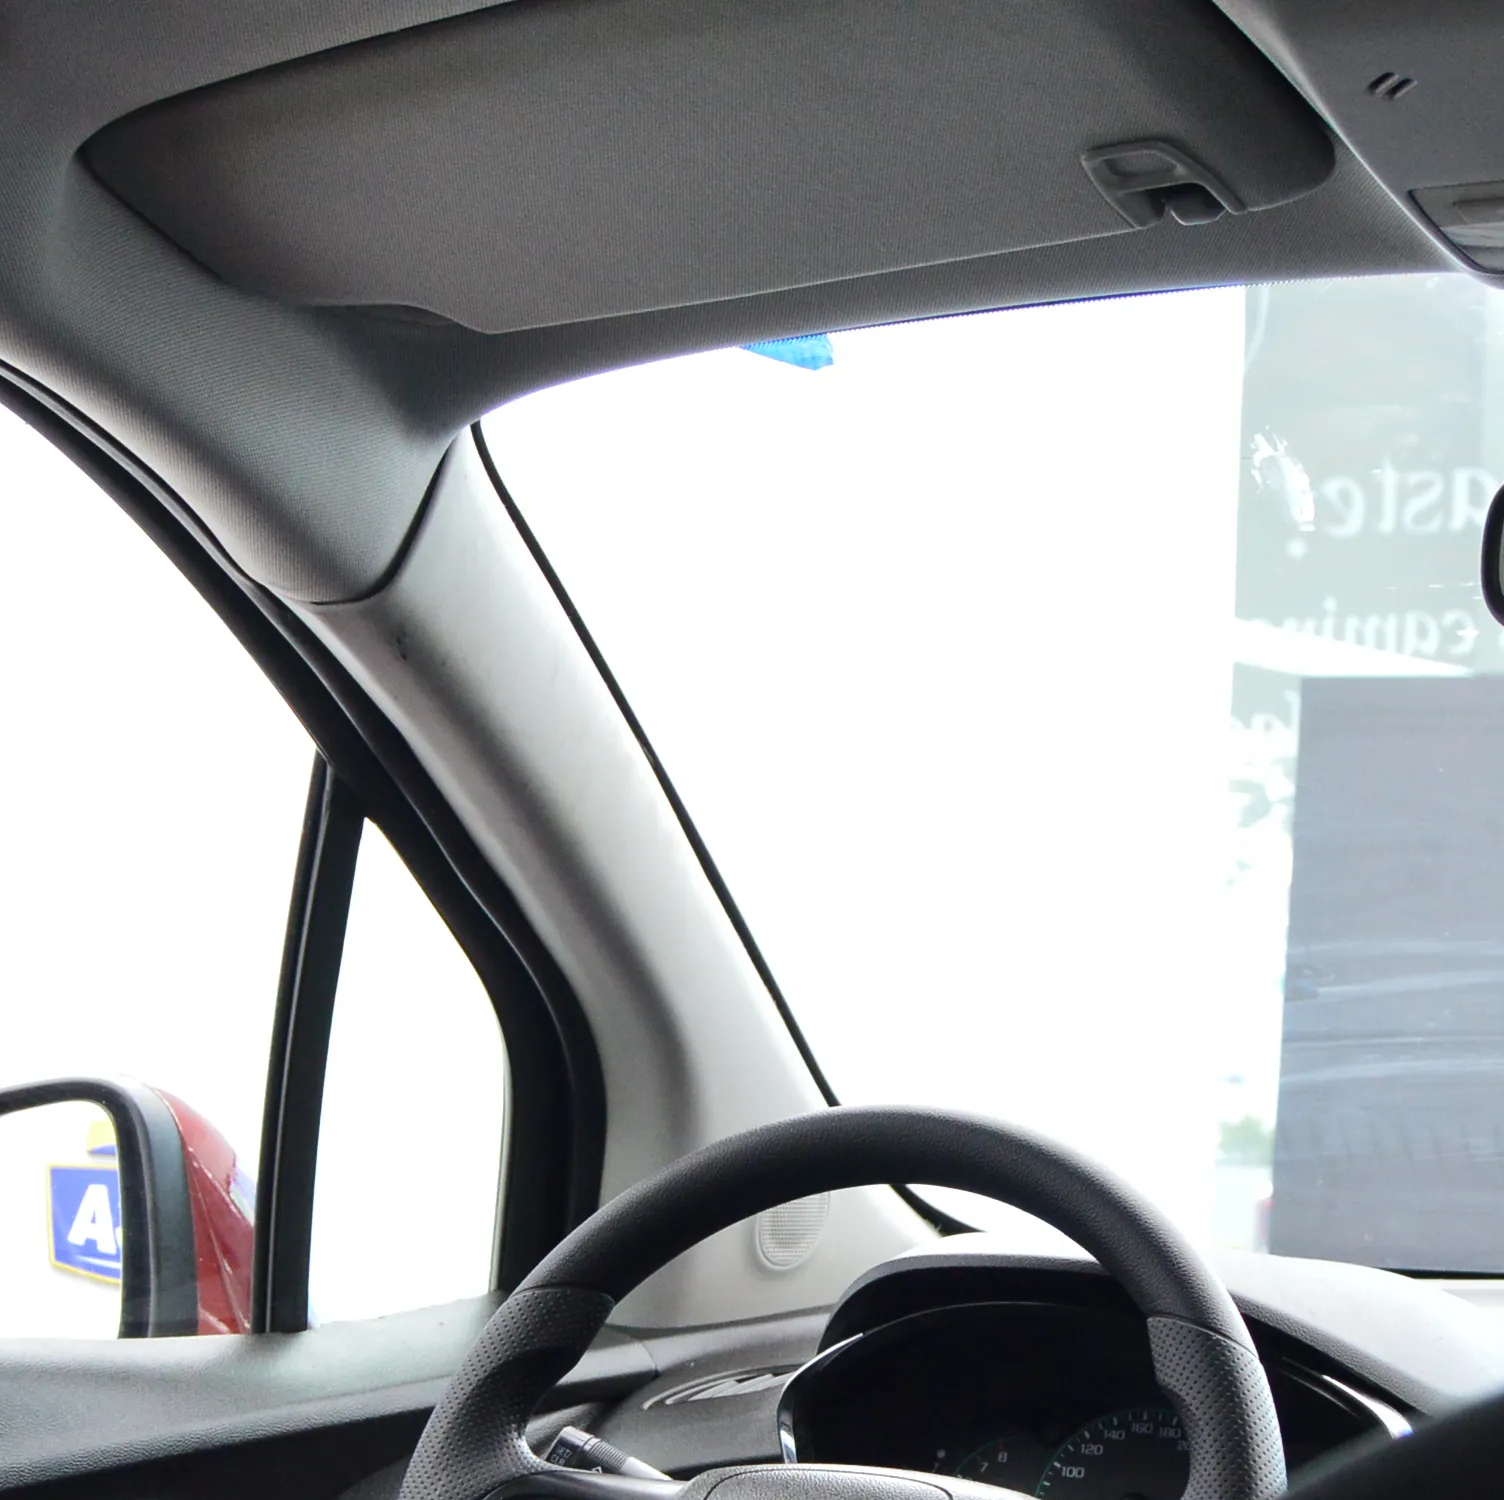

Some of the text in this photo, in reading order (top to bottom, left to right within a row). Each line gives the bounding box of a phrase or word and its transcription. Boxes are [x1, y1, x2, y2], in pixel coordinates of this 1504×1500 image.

[67, 1183, 123, 1256] A
[1104, 1429, 1126, 1441] 140
[1080, 1444, 1104, 1456] 120
[997, 1451, 1008, 1463] 8
[980, 1461, 989, 1473] 7
[1061, 1465, 1085, 1479] 100
